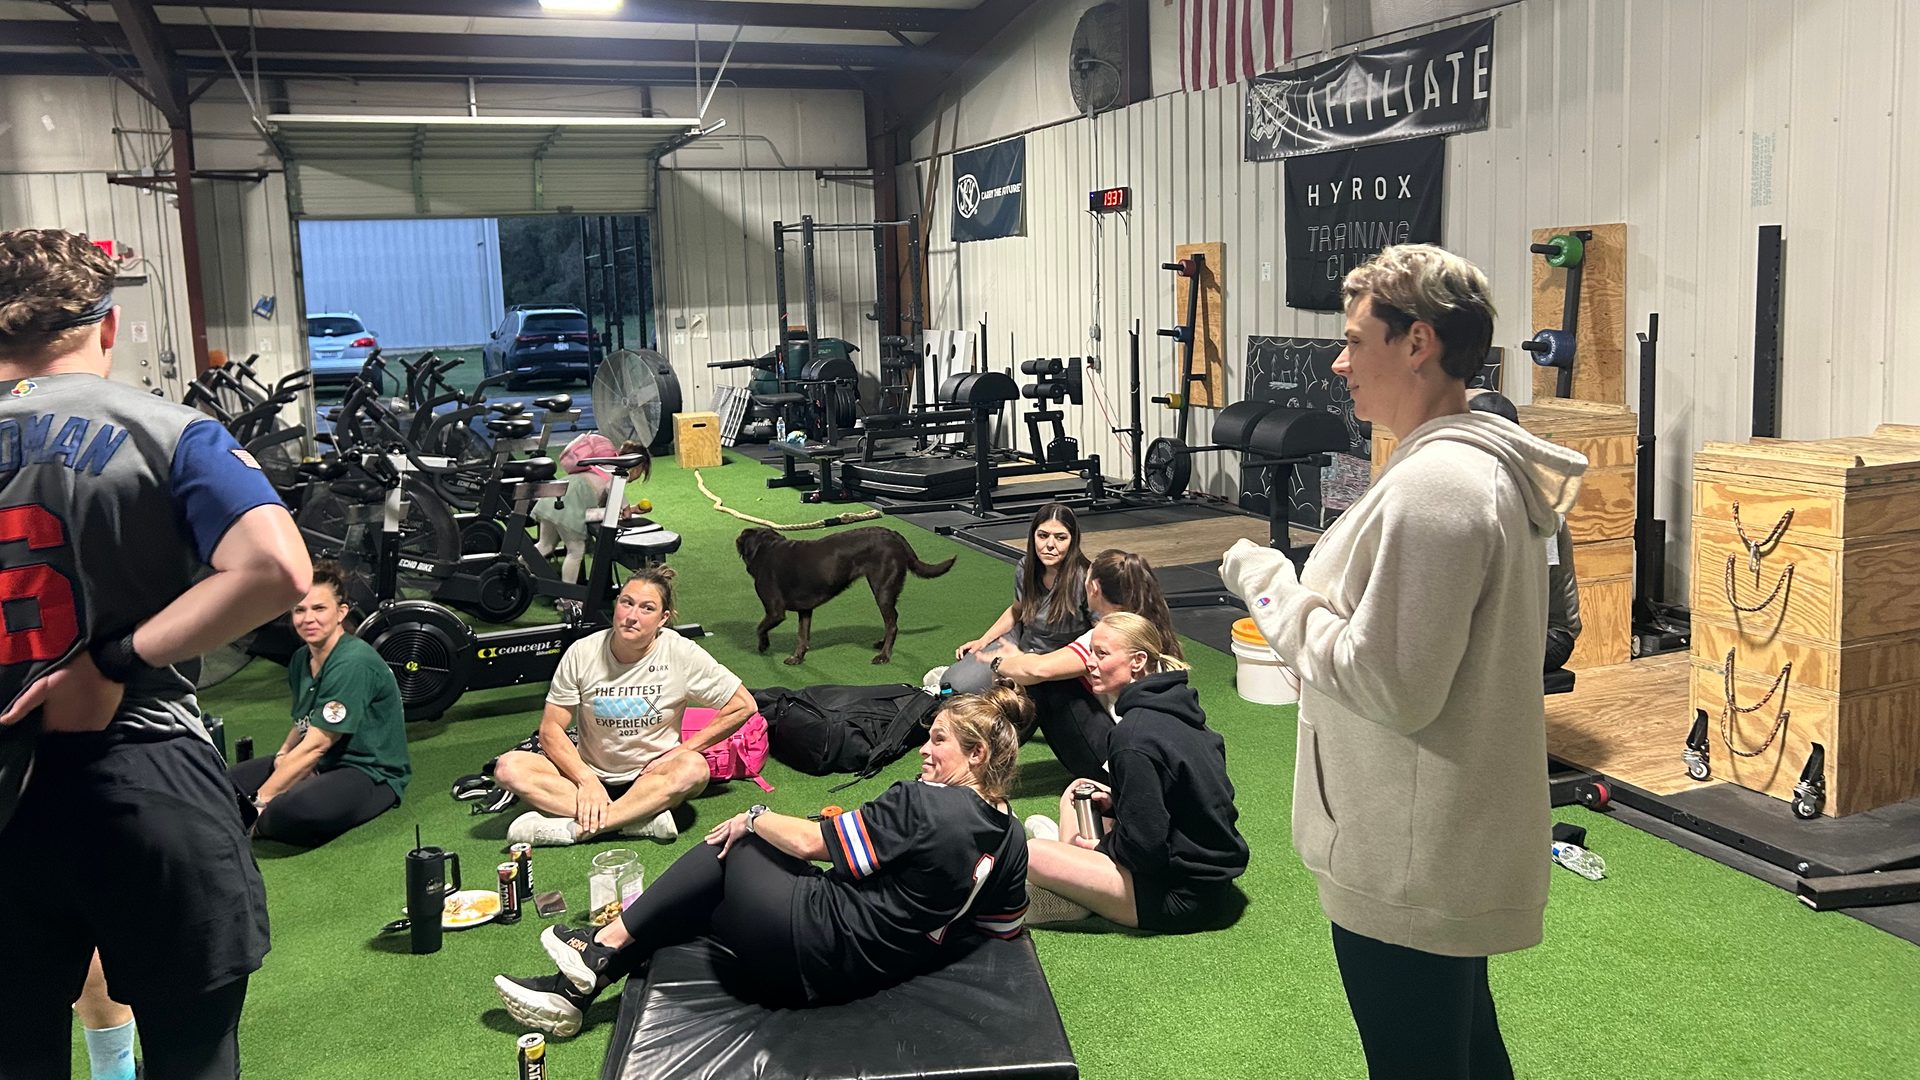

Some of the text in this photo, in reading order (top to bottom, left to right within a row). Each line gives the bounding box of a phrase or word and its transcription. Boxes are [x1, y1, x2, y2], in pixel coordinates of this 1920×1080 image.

[1306, 44, 1489, 131] AFFILIATE
[1307, 174, 1412, 207] HYROX
[1307, 220, 1410, 252] TRAINING
[1326, 252, 1379, 281] CL
[398, 558, 435, 573] ECHO BIKE
[498, 639, 562, 655] concept 2
[595, 684, 663, 697] THE FITTEST
[596, 714, 663, 729] EXPERIENCE
[619, 728, 640, 737] 2023
[500, 882, 510, 910] TRULY
[566, 936, 588, 952] HOKA
